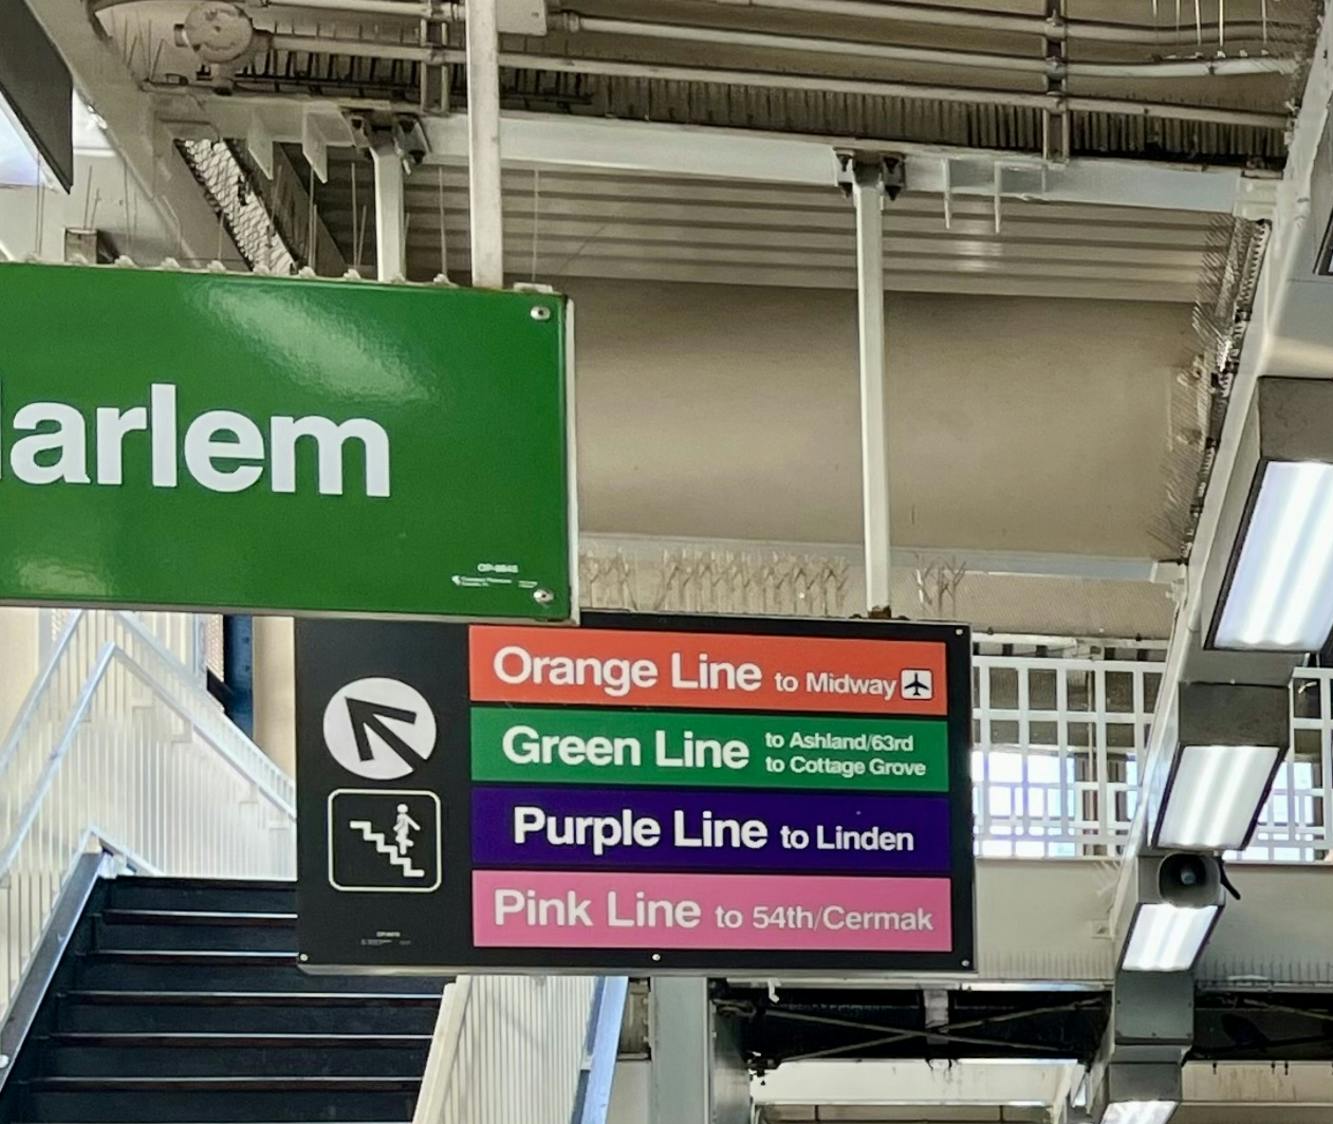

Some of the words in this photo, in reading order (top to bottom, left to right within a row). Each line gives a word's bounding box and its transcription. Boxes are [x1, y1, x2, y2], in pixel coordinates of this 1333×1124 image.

[0, 383, 391, 497] arlem
[493, 646, 658, 696] Orange
[671, 652, 763, 692] Line
[775, 673, 799, 693] to
[806, 673, 897, 700] Midway
[502, 725, 641, 767] Green
[655, 730, 750, 769] Line
[765, 733, 786, 750] to
[789, 733, 914, 752] Ashland/63rd
[765, 756, 786, 775] to
[789, 756, 867, 779] Cottage
[869, 758, 927, 777] Grove
[513, 806, 661, 856] Purple
[674, 810, 768, 848] Line
[780, 828, 810, 850] to
[816, 825, 915, 852] Linden
[494, 888, 594, 928] Pink
[607, 891, 702, 929] Line
[715, 906, 743, 930] to
[752, 905, 935, 932] 54th/Cermak
